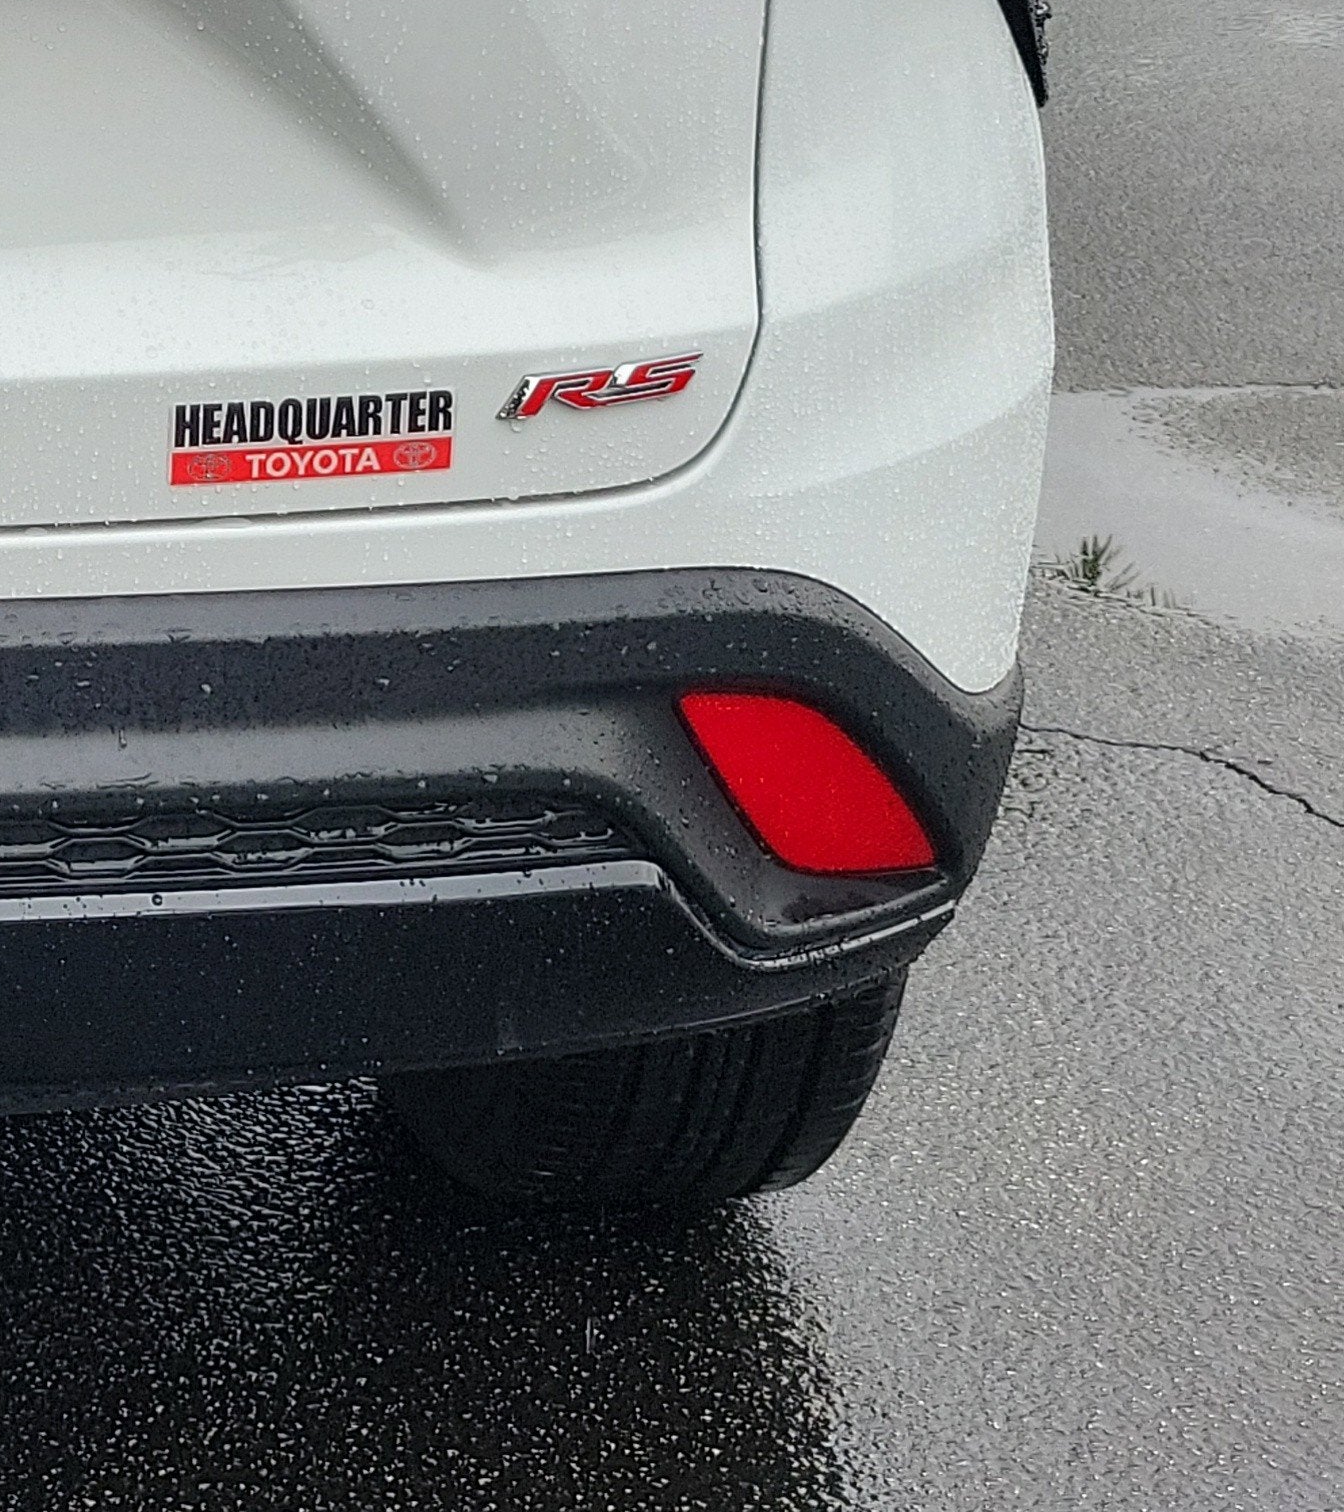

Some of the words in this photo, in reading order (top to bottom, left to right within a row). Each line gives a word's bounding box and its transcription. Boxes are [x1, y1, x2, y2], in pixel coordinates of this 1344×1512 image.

[494, 350, 704, 421] RS
[174, 389, 453, 448] HEADQUARTER
[245, 448, 380, 478] TOYOTA
